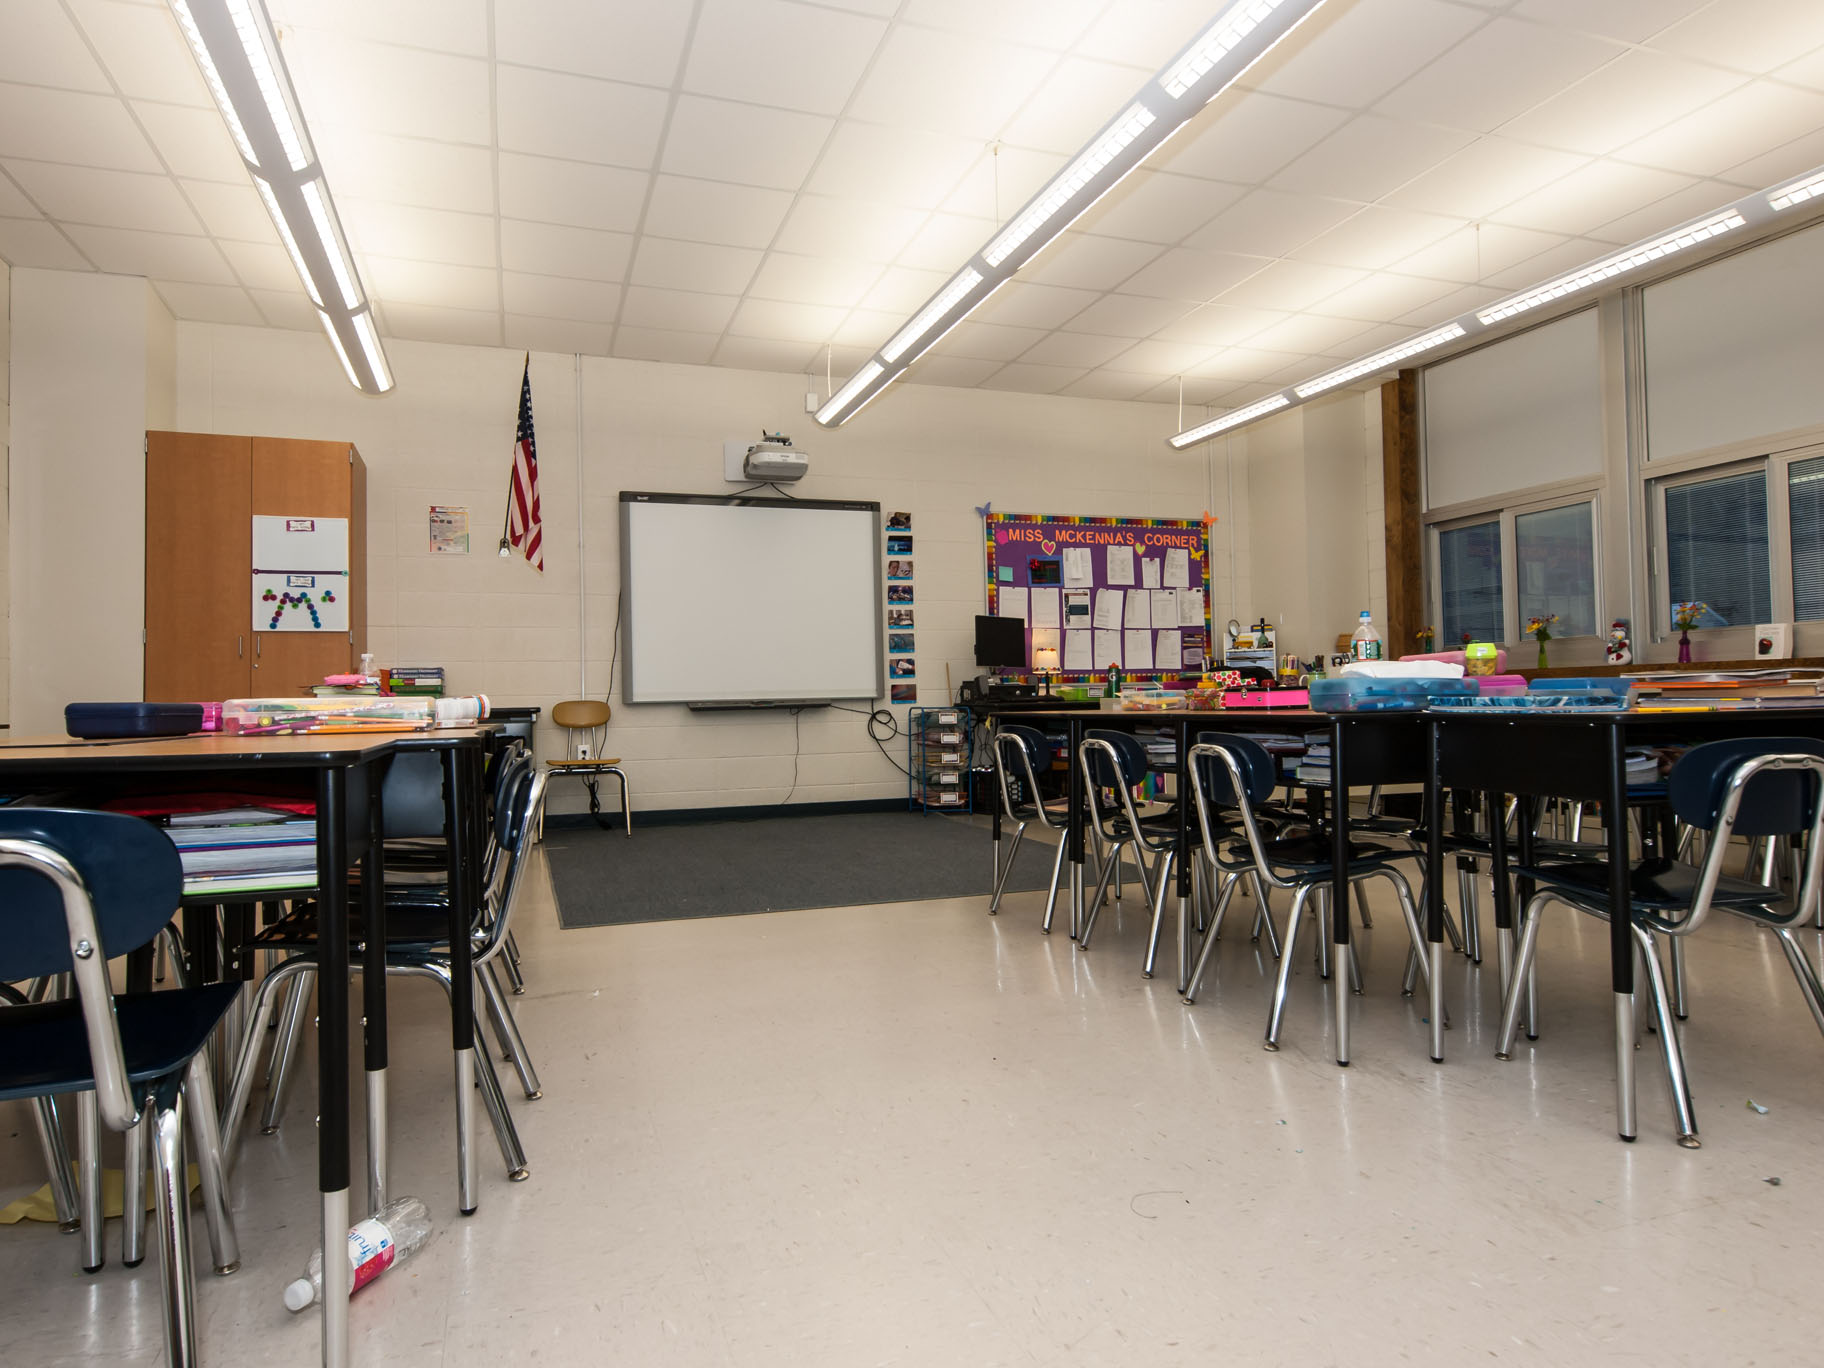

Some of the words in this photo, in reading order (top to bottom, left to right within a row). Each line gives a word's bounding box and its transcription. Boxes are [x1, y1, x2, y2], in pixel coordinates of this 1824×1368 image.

[1008, 528, 1043, 542] MISS
[1055, 529, 1134, 545] MCKENNA'S
[1144, 533, 1198, 548] CORNER
